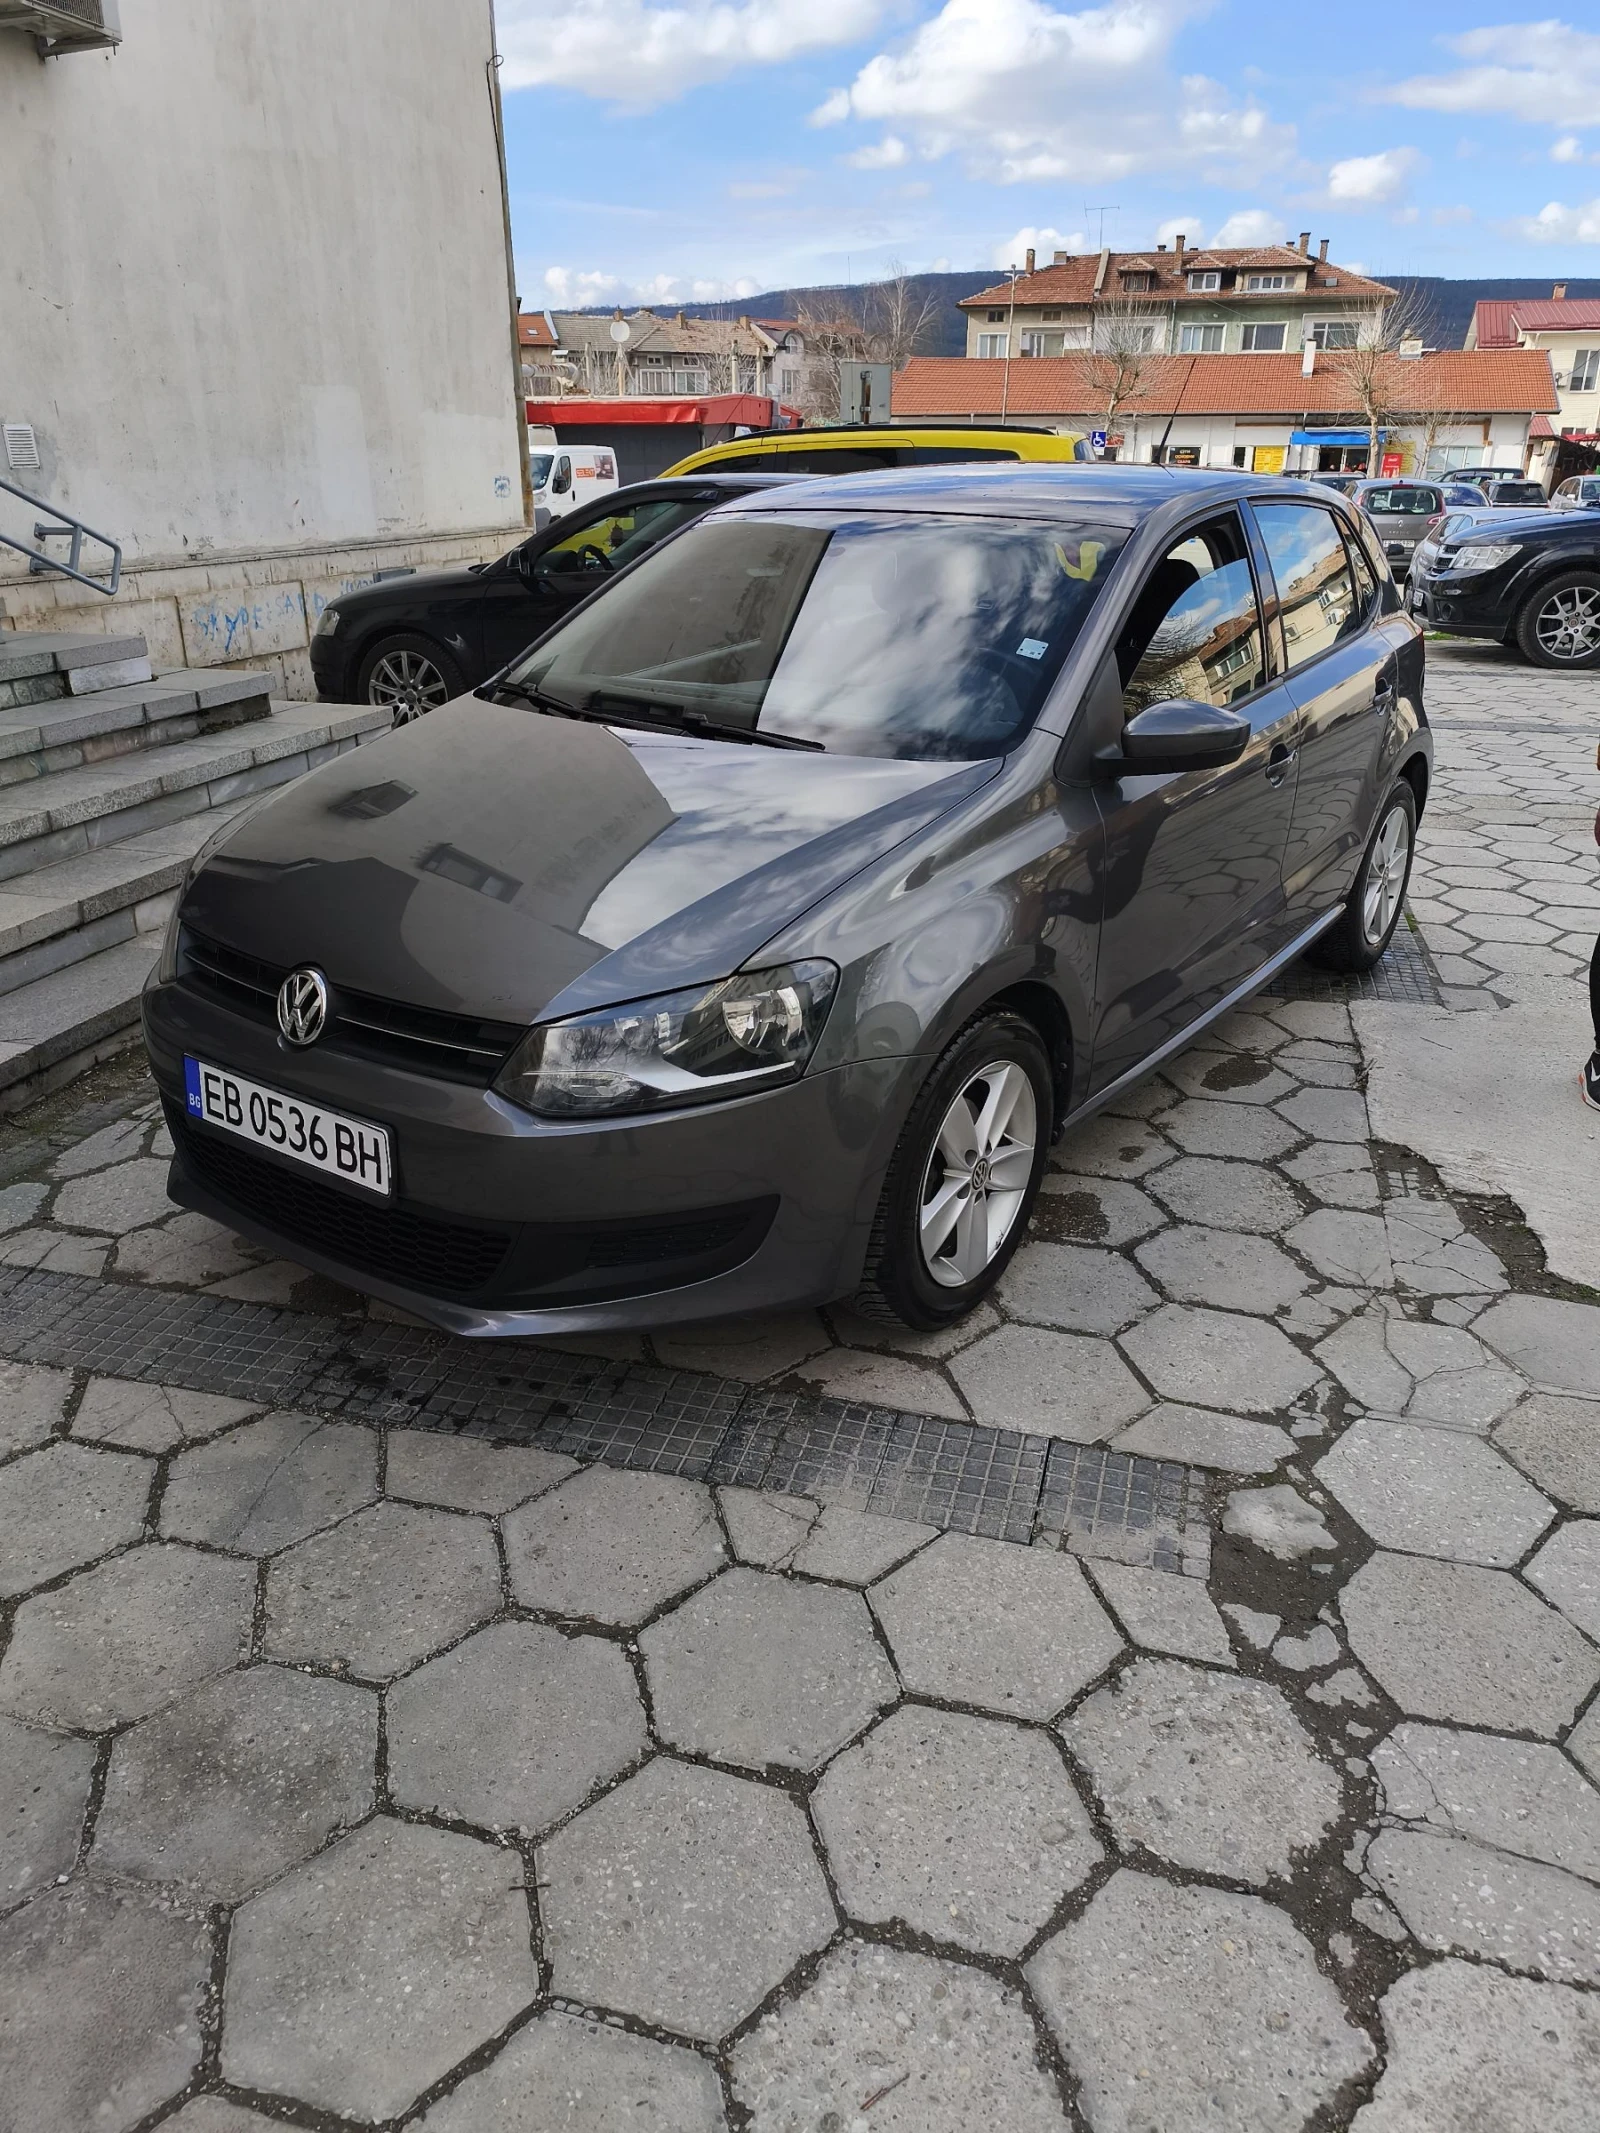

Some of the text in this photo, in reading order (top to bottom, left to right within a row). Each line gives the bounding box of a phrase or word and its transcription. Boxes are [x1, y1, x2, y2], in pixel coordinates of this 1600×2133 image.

[189, 1093, 201, 1108] BG
[203, 1071, 382, 1184] EB 0536 BH
